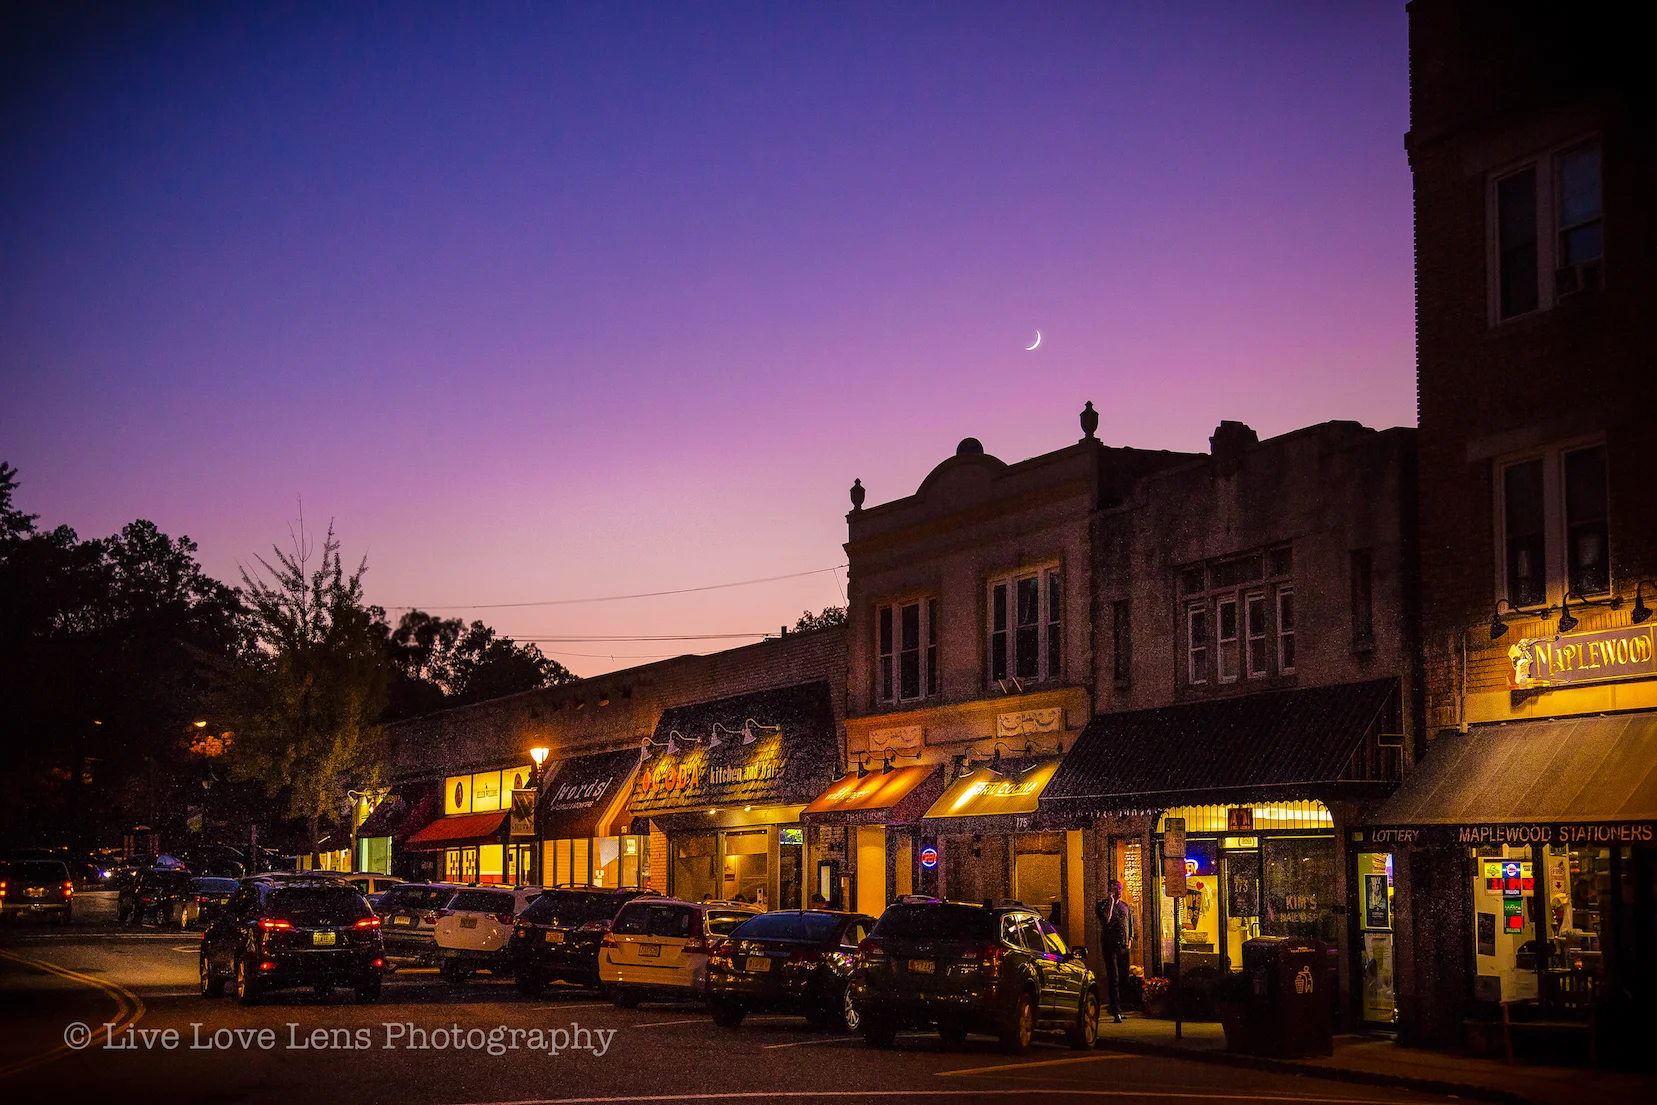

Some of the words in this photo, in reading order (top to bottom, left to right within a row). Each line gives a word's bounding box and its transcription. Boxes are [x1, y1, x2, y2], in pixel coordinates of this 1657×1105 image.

[1535, 635, 1652, 677] MAPLEWOOD
[710, 765, 741, 784] kitchen
[744, 762, 759, 780] and
[761, 761, 776, 779] bar
[972, 782, 1001, 797] BRIL
[998, 782, 1040, 797] COCINA
[1372, 829, 1420, 843] LOTTERY
[1458, 826, 1551, 843] MAPLEWOOD
[1559, 825, 1653, 842] STATIONERS
